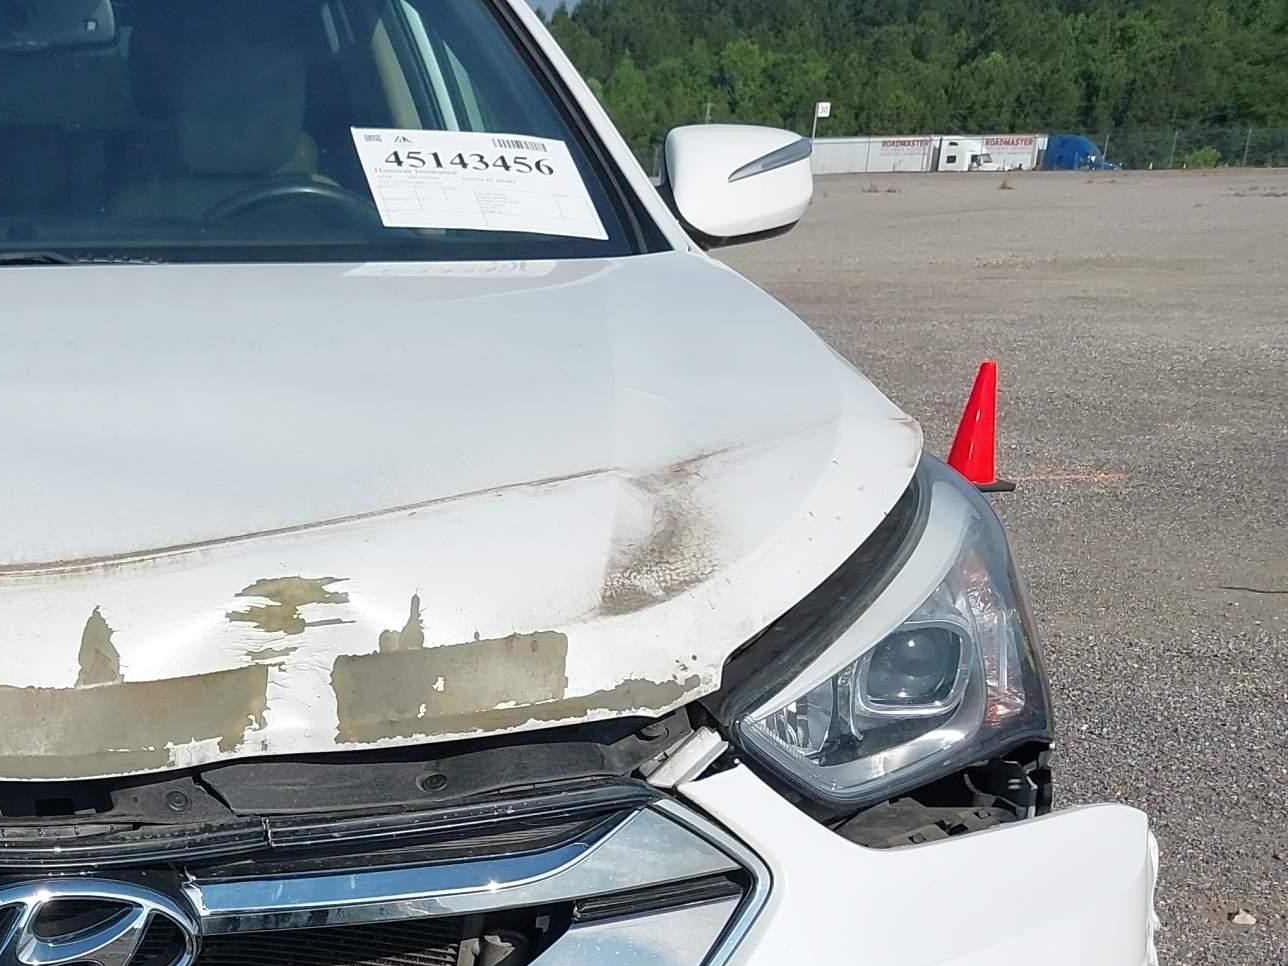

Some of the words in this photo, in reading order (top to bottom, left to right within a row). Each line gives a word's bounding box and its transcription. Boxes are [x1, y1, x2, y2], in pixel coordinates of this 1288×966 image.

[881, 139, 930, 147] ROADMASTER
[984, 137, 1034, 146] ROADMASTER
[385, 150, 554, 177] 45143456
